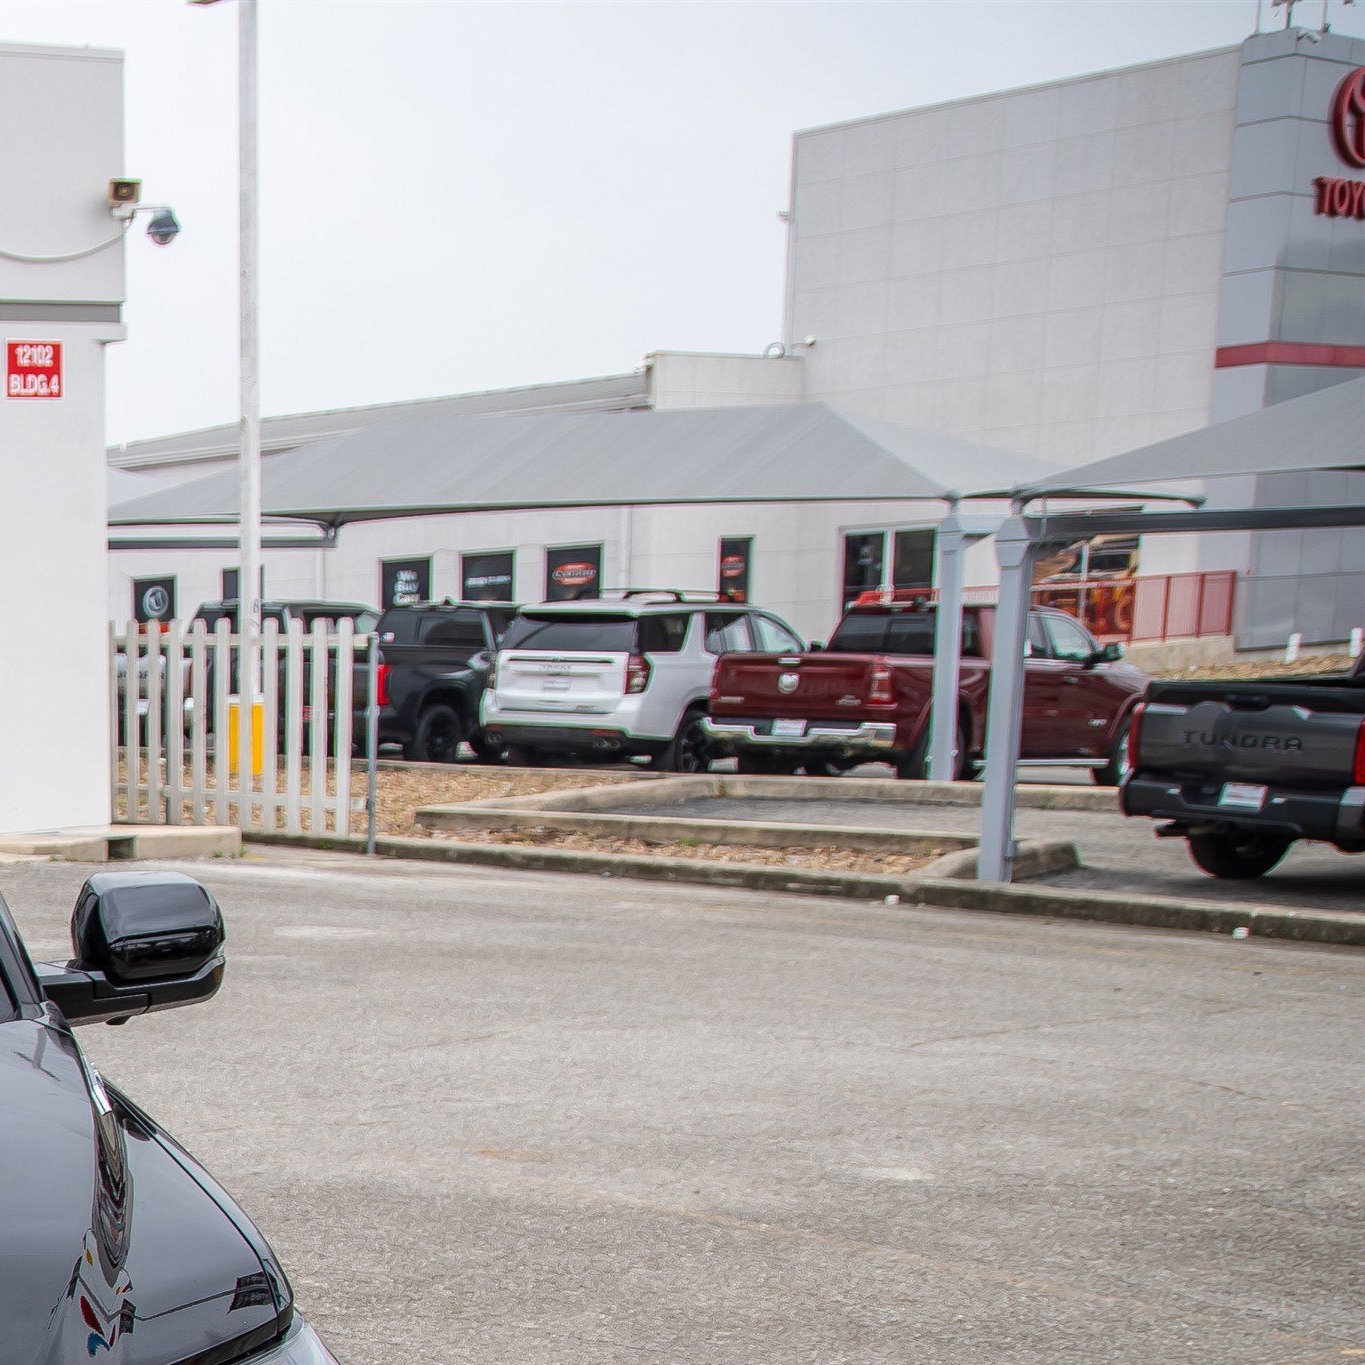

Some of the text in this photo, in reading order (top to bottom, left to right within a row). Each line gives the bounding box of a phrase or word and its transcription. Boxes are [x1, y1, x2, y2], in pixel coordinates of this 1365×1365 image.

[1313, 177, 1365, 220] TOY
[15, 345, 54, 367] 12102
[1183, 730, 1303, 753] TUNDRA
